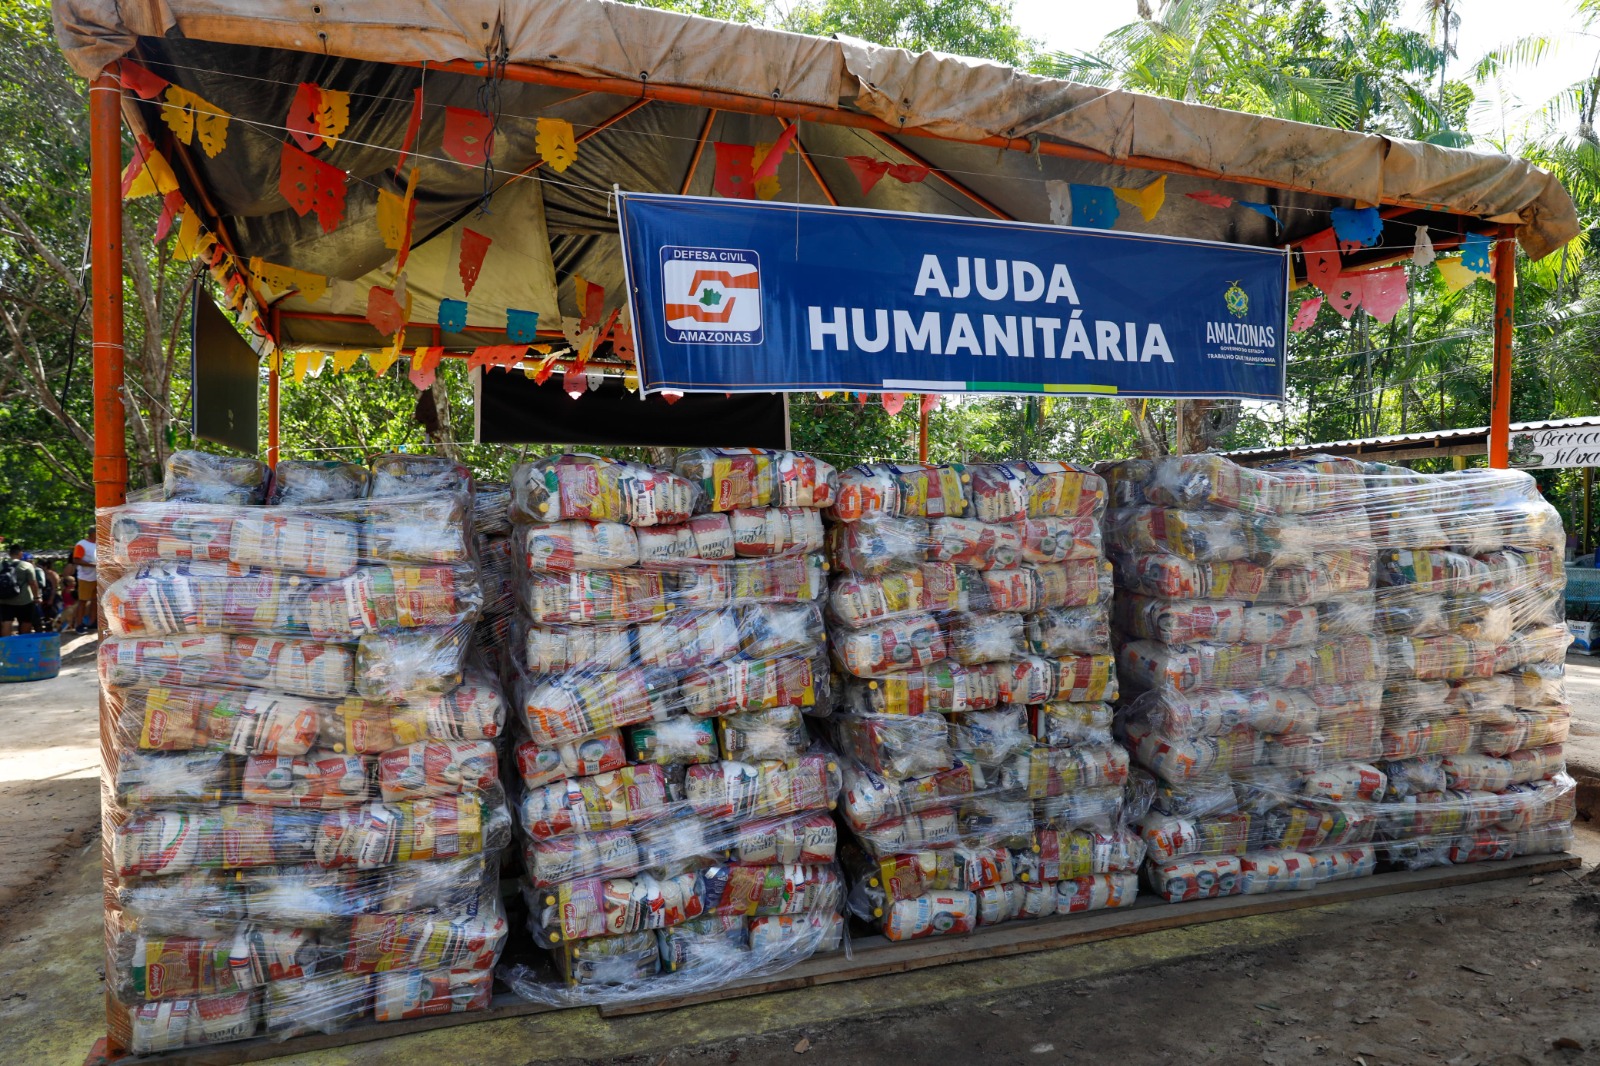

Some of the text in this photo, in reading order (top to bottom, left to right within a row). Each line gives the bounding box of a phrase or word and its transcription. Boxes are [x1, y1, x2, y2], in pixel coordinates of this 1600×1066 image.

[673, 250, 747, 262] DEFESA CIVIL
[913, 253, 1081, 305] AJUDA
[678, 330, 752, 343] AMAZONAS
[808, 305, 1175, 363] HUMANITÁRIA
[1206, 321, 1275, 348] AMAZONAS
